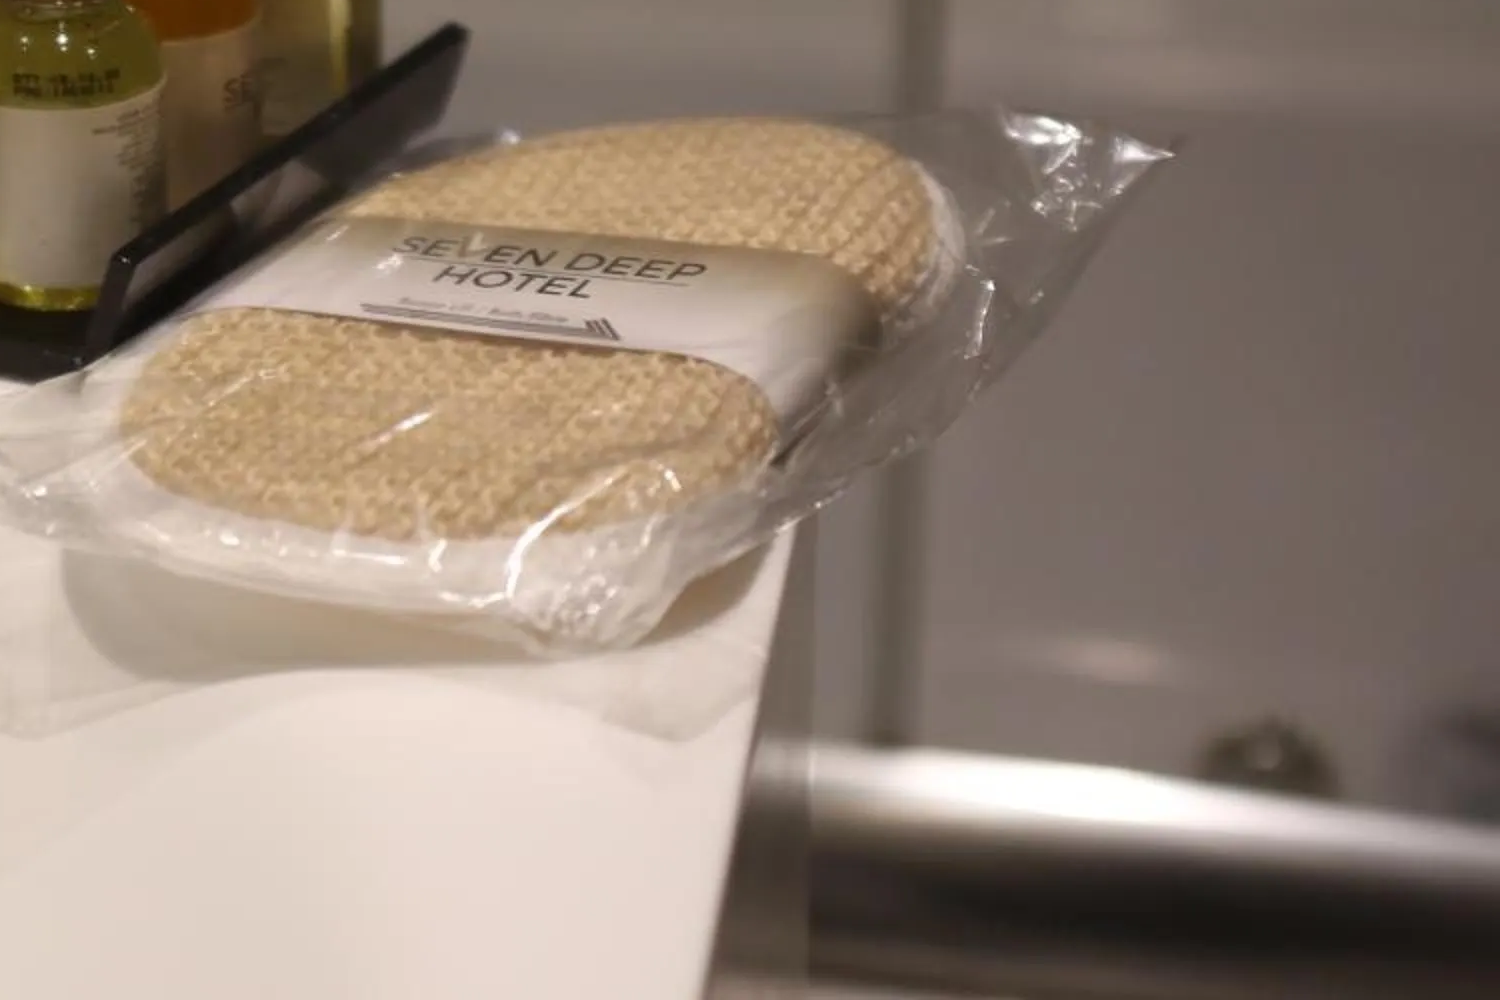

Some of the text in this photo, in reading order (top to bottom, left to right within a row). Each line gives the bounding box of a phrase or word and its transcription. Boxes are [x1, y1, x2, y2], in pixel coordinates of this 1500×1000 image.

[395, 231, 707, 281] SEVEN DEEP
[434, 265, 591, 299] HOTEL
